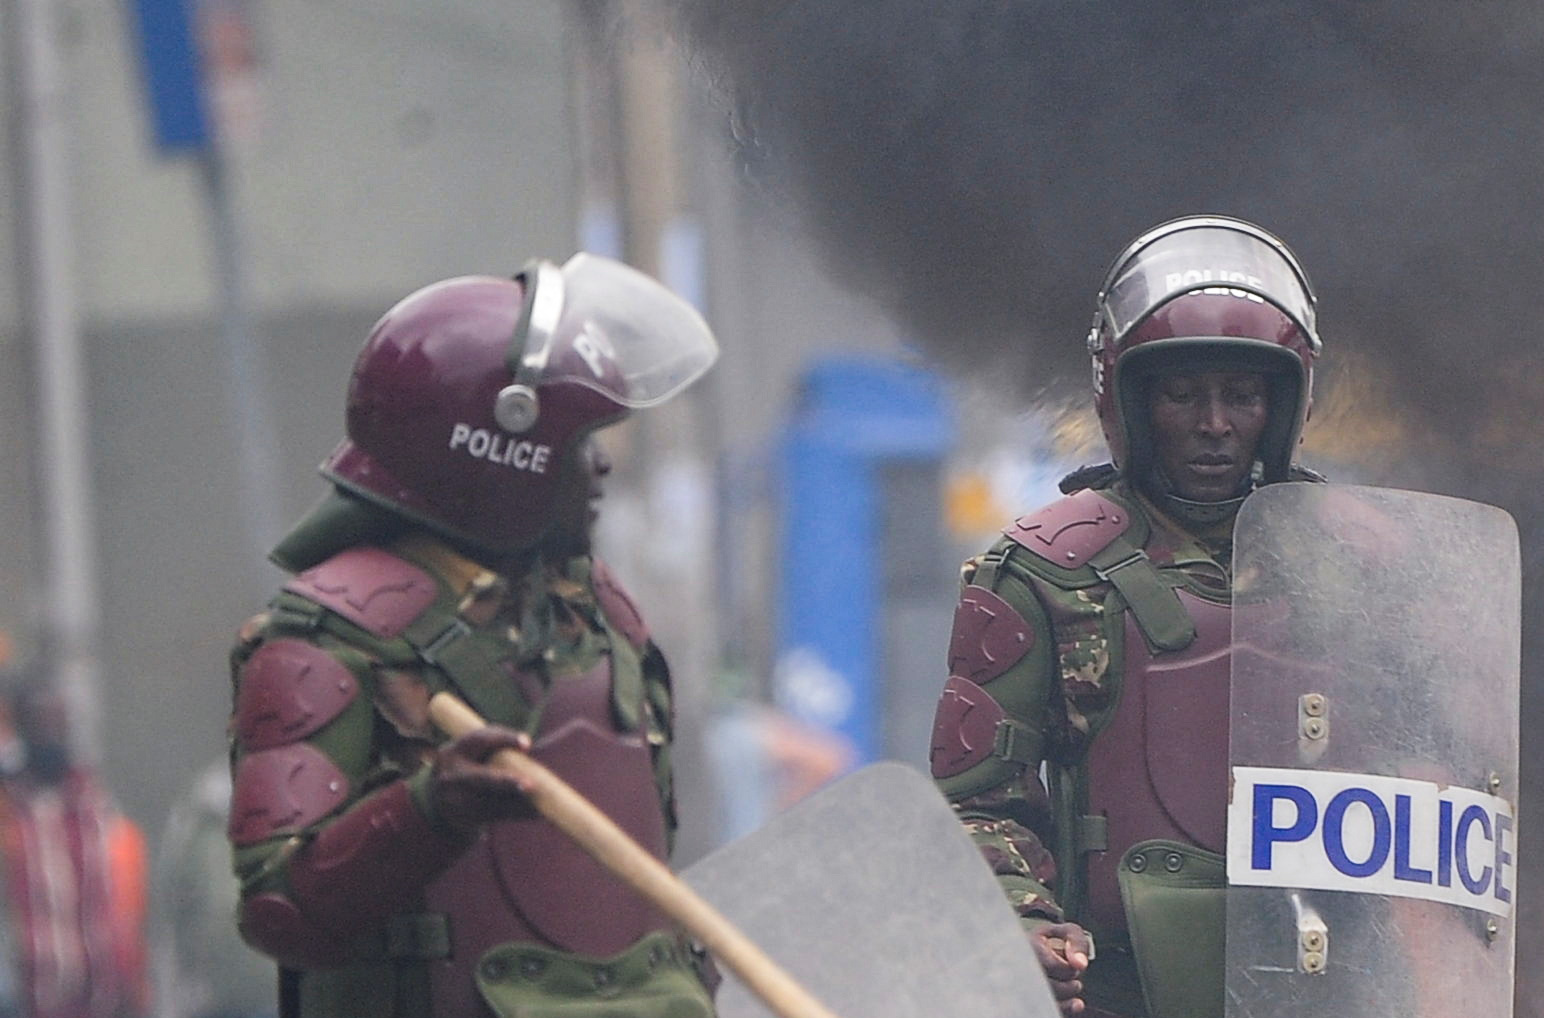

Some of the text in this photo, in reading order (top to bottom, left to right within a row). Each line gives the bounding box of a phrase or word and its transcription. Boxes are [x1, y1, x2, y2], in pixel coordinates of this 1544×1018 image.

[1166, 269, 1264, 304] POLICE
[449, 422, 551, 473] POLICE
[1251, 783, 1512, 904] POLICE
